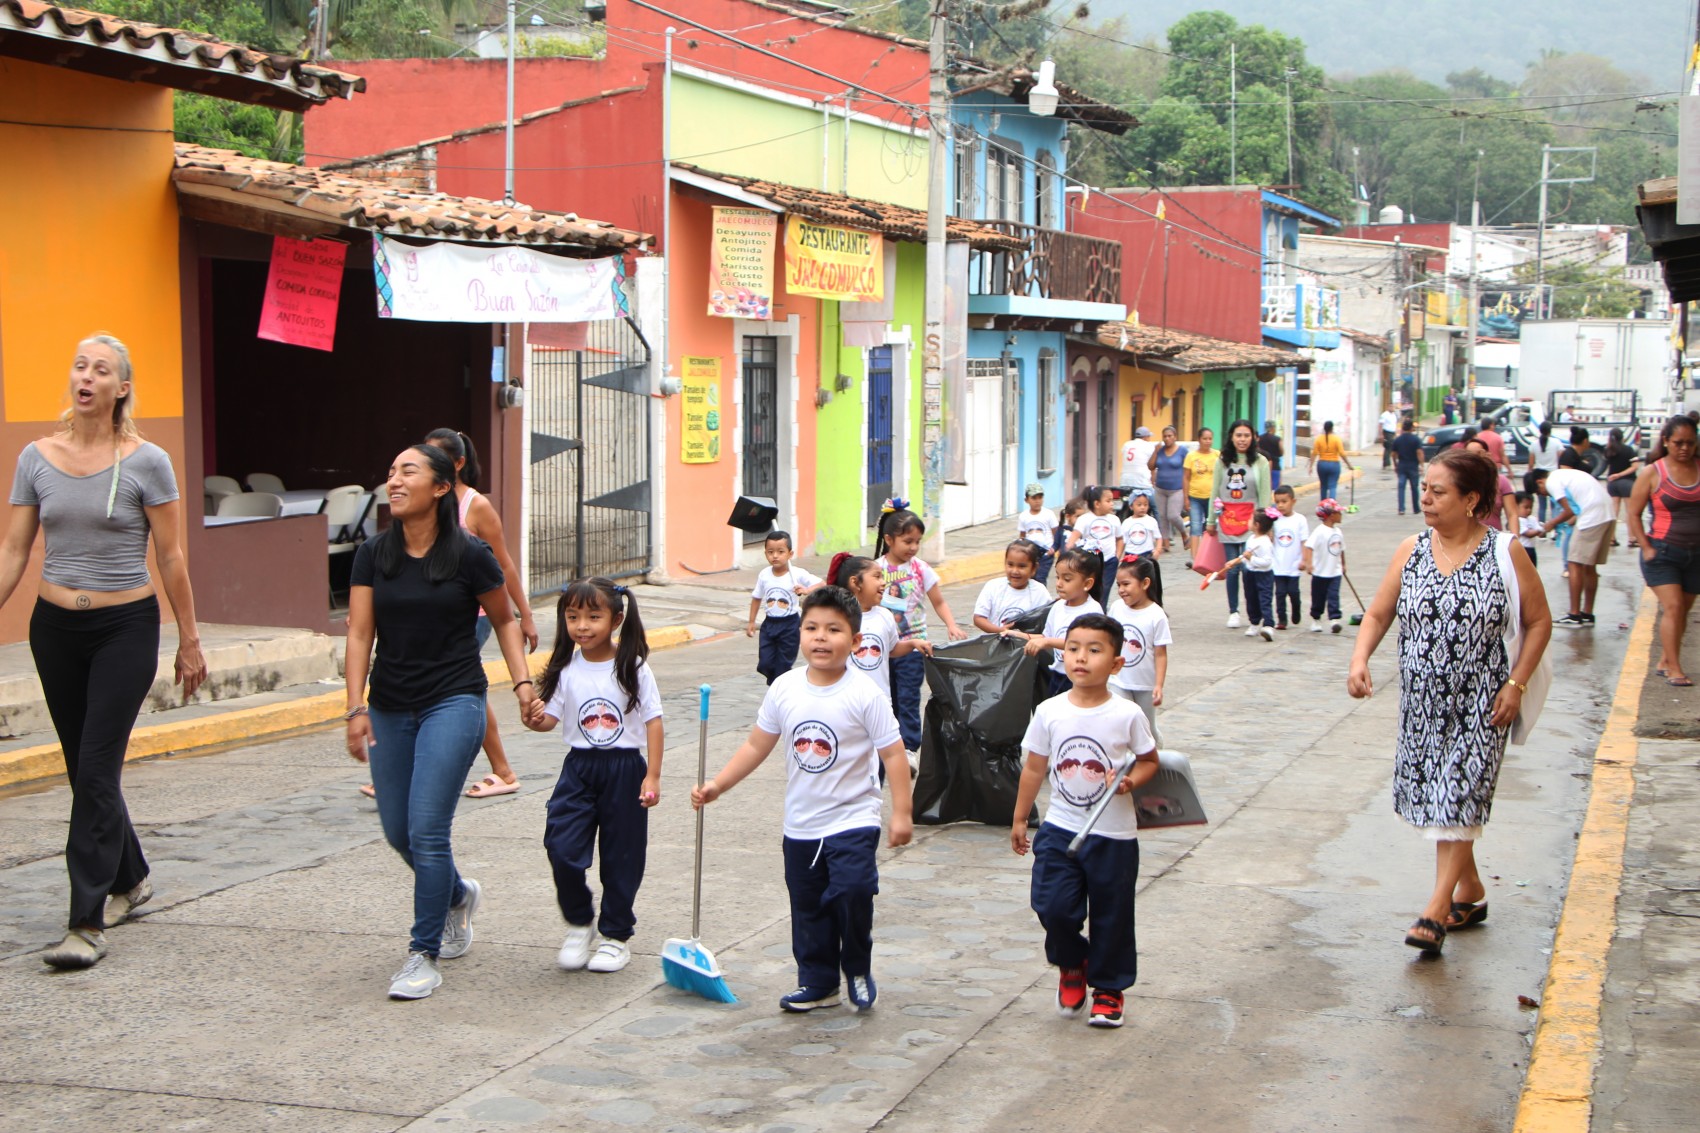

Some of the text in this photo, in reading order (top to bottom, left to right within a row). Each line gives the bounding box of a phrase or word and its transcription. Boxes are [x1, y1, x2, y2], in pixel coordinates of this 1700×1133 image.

[716, 228, 772, 237] Desayunos
[720, 237, 767, 246] Antojitos
[725, 246, 762, 254] Comida
[725, 254, 762, 263] Corrida
[720, 262, 764, 271] Mariscos
[732, 271, 763, 280] Gusto
[467, 278, 517, 313] Buen
[276, 311, 326, 329] ANTOJITOS
[1126, 447, 1137, 462] 5
